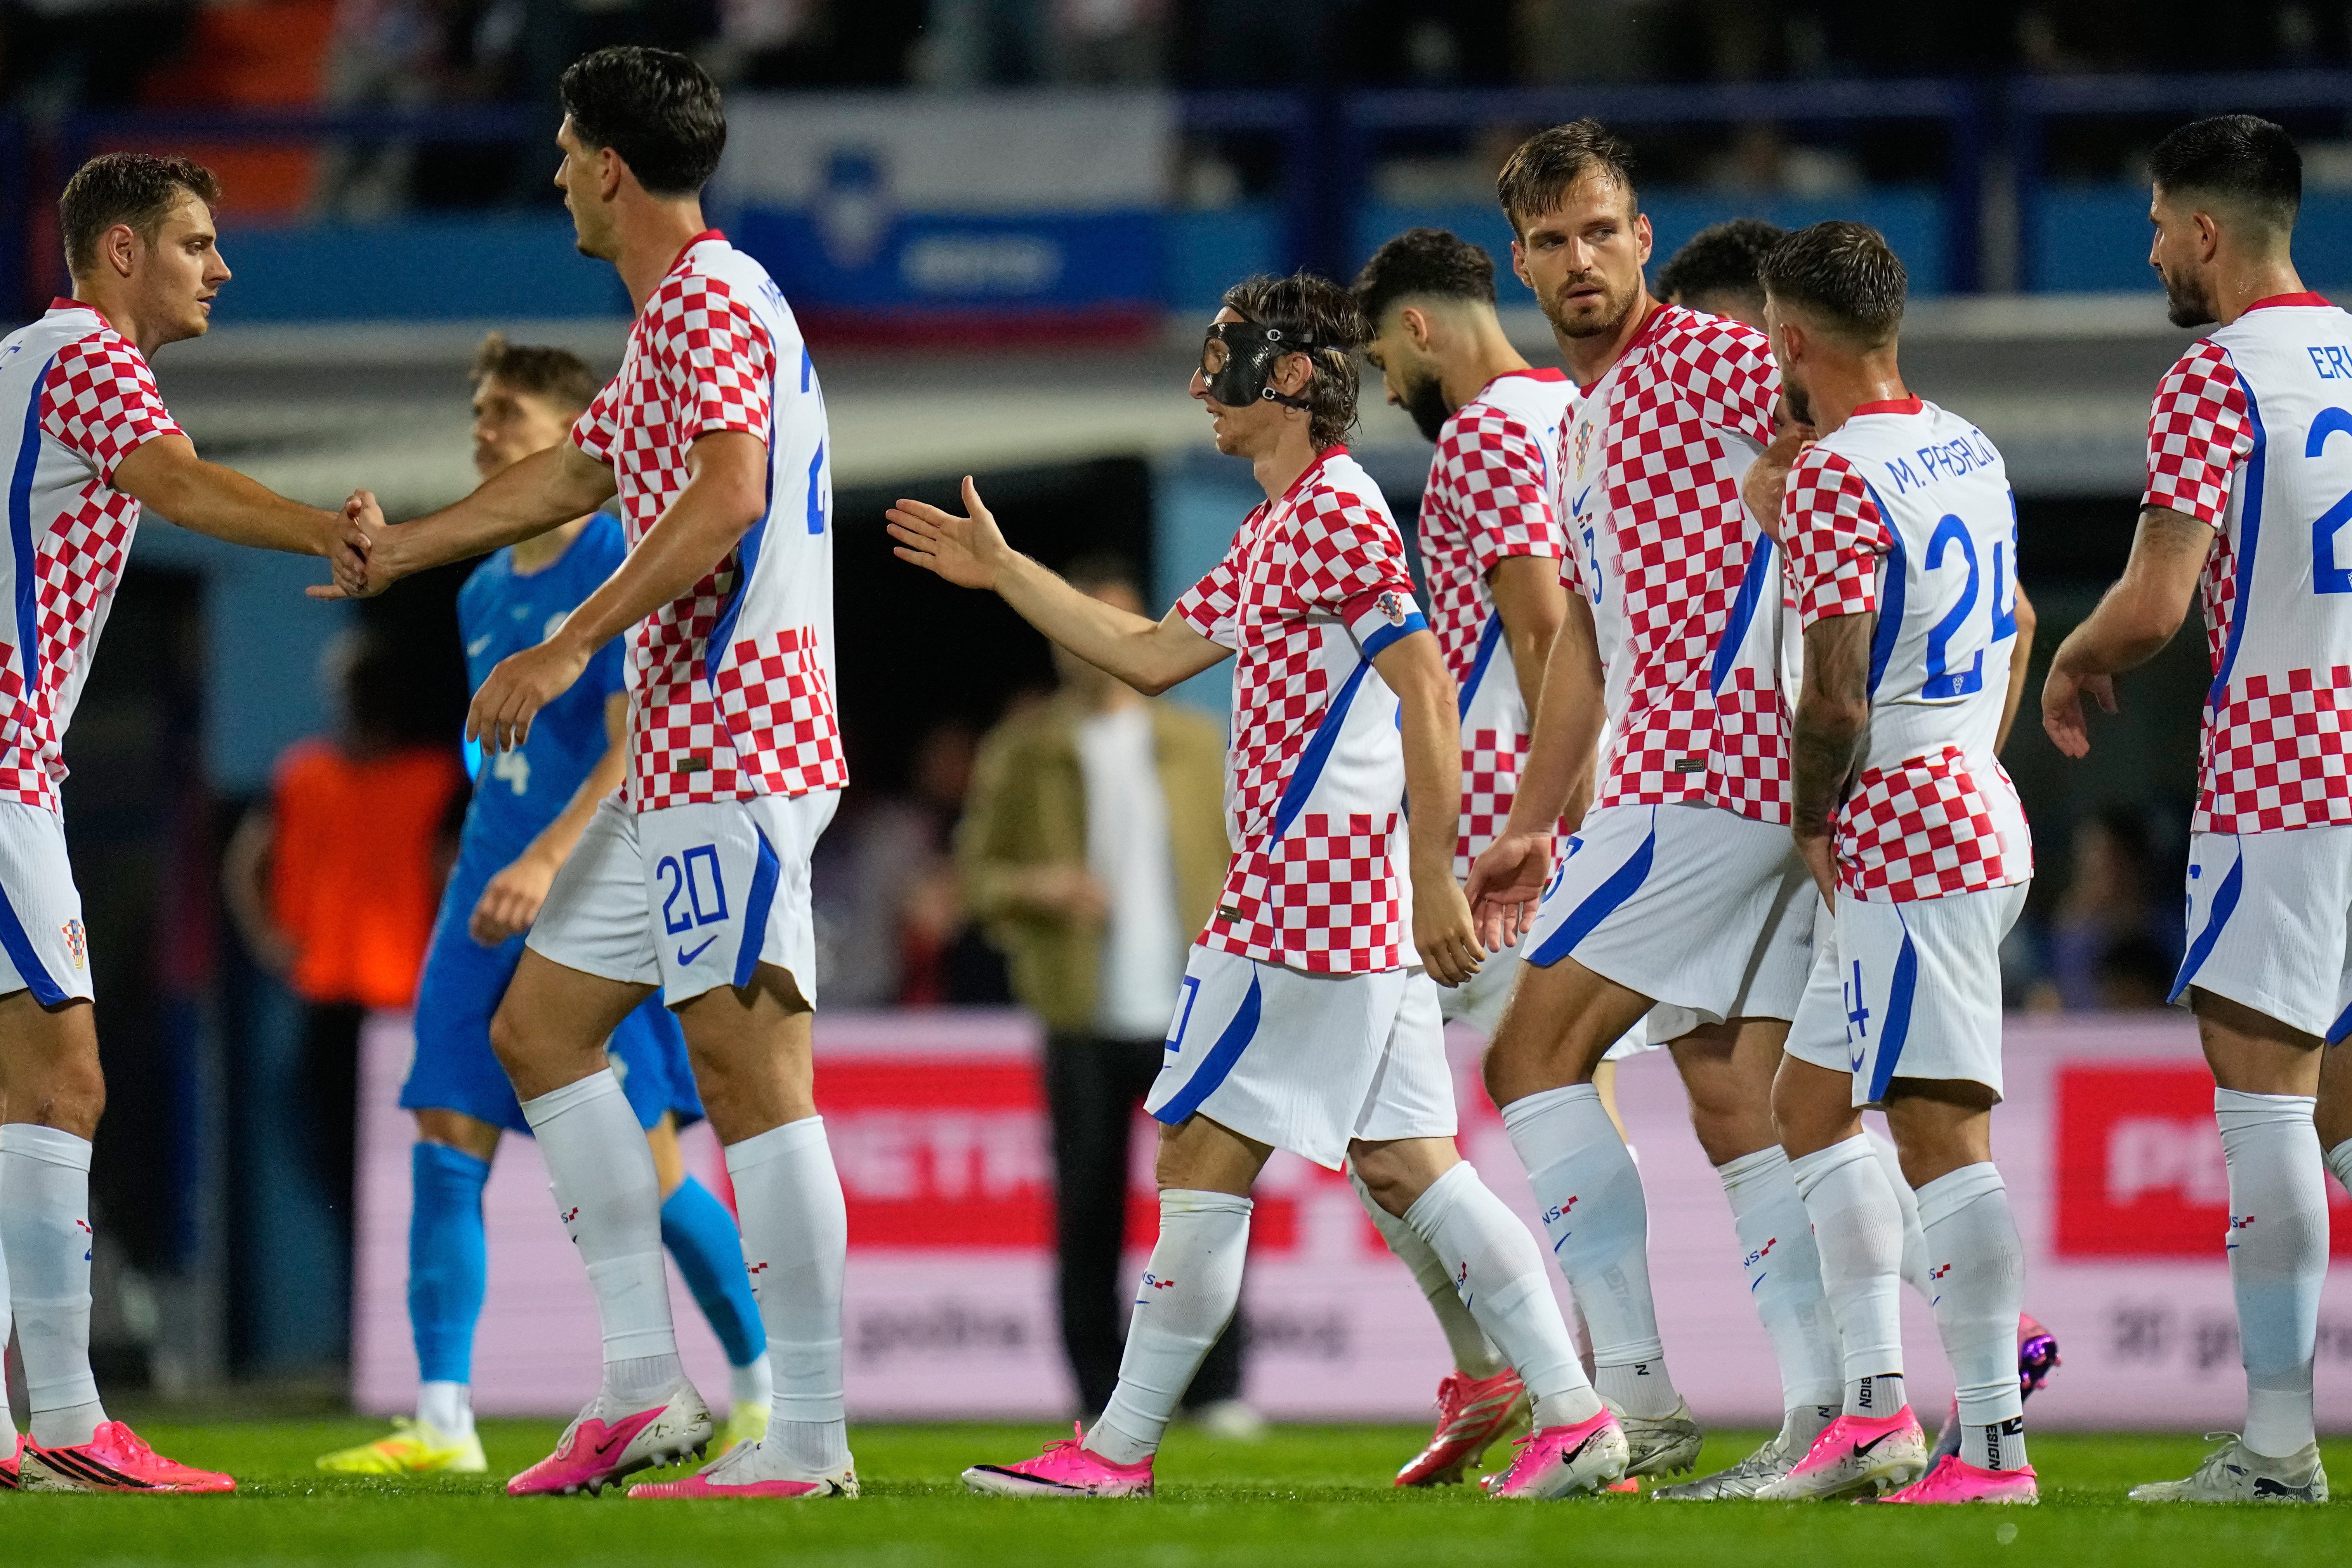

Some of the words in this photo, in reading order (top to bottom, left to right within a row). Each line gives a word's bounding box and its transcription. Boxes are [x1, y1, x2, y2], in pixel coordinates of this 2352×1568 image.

[1884, 457, 1926, 494] M.
[1583, 526, 1602, 604] 3
[656, 843, 729, 936] 20
[1844, 959, 1870, 1044] 4
